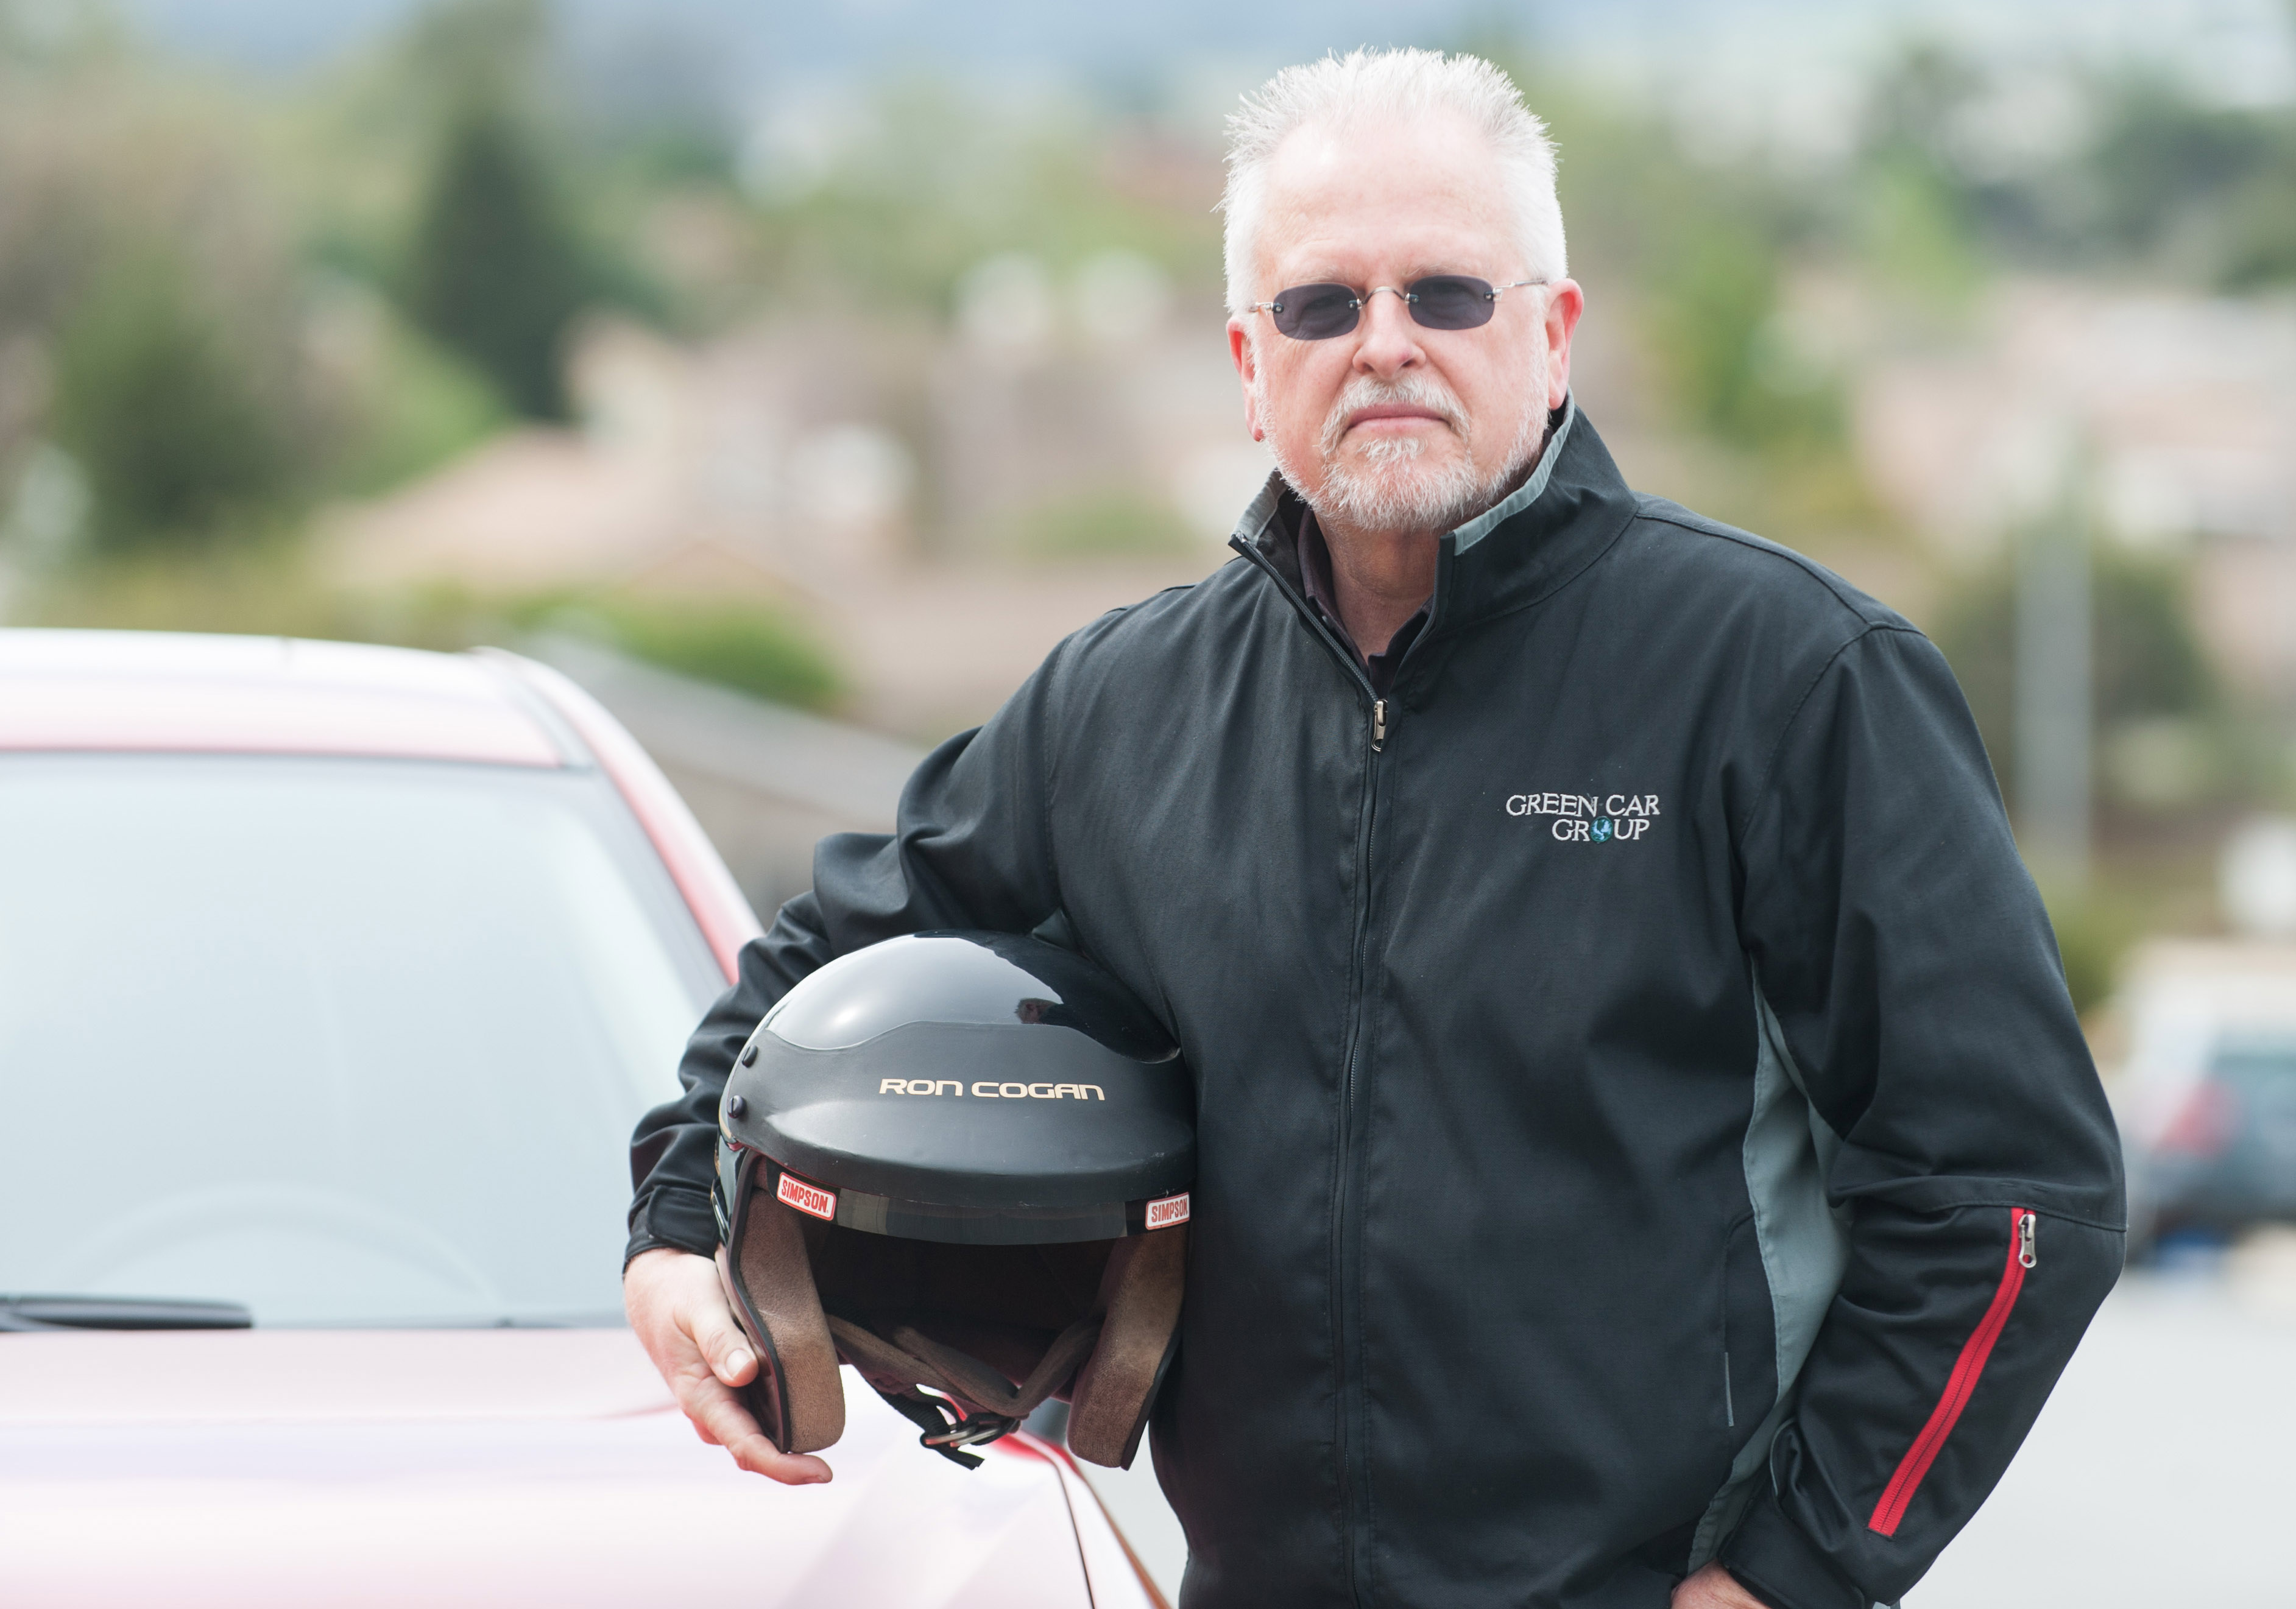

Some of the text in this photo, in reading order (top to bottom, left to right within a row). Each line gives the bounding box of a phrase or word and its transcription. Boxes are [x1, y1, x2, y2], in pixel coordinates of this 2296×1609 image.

[1506, 792, 1661, 817] GREEN CAR
[879, 1078, 1105, 1100] RON COGAN
[781, 1179, 828, 1213] SIMPSON
[1151, 1197, 1188, 1223] SIMPSON
